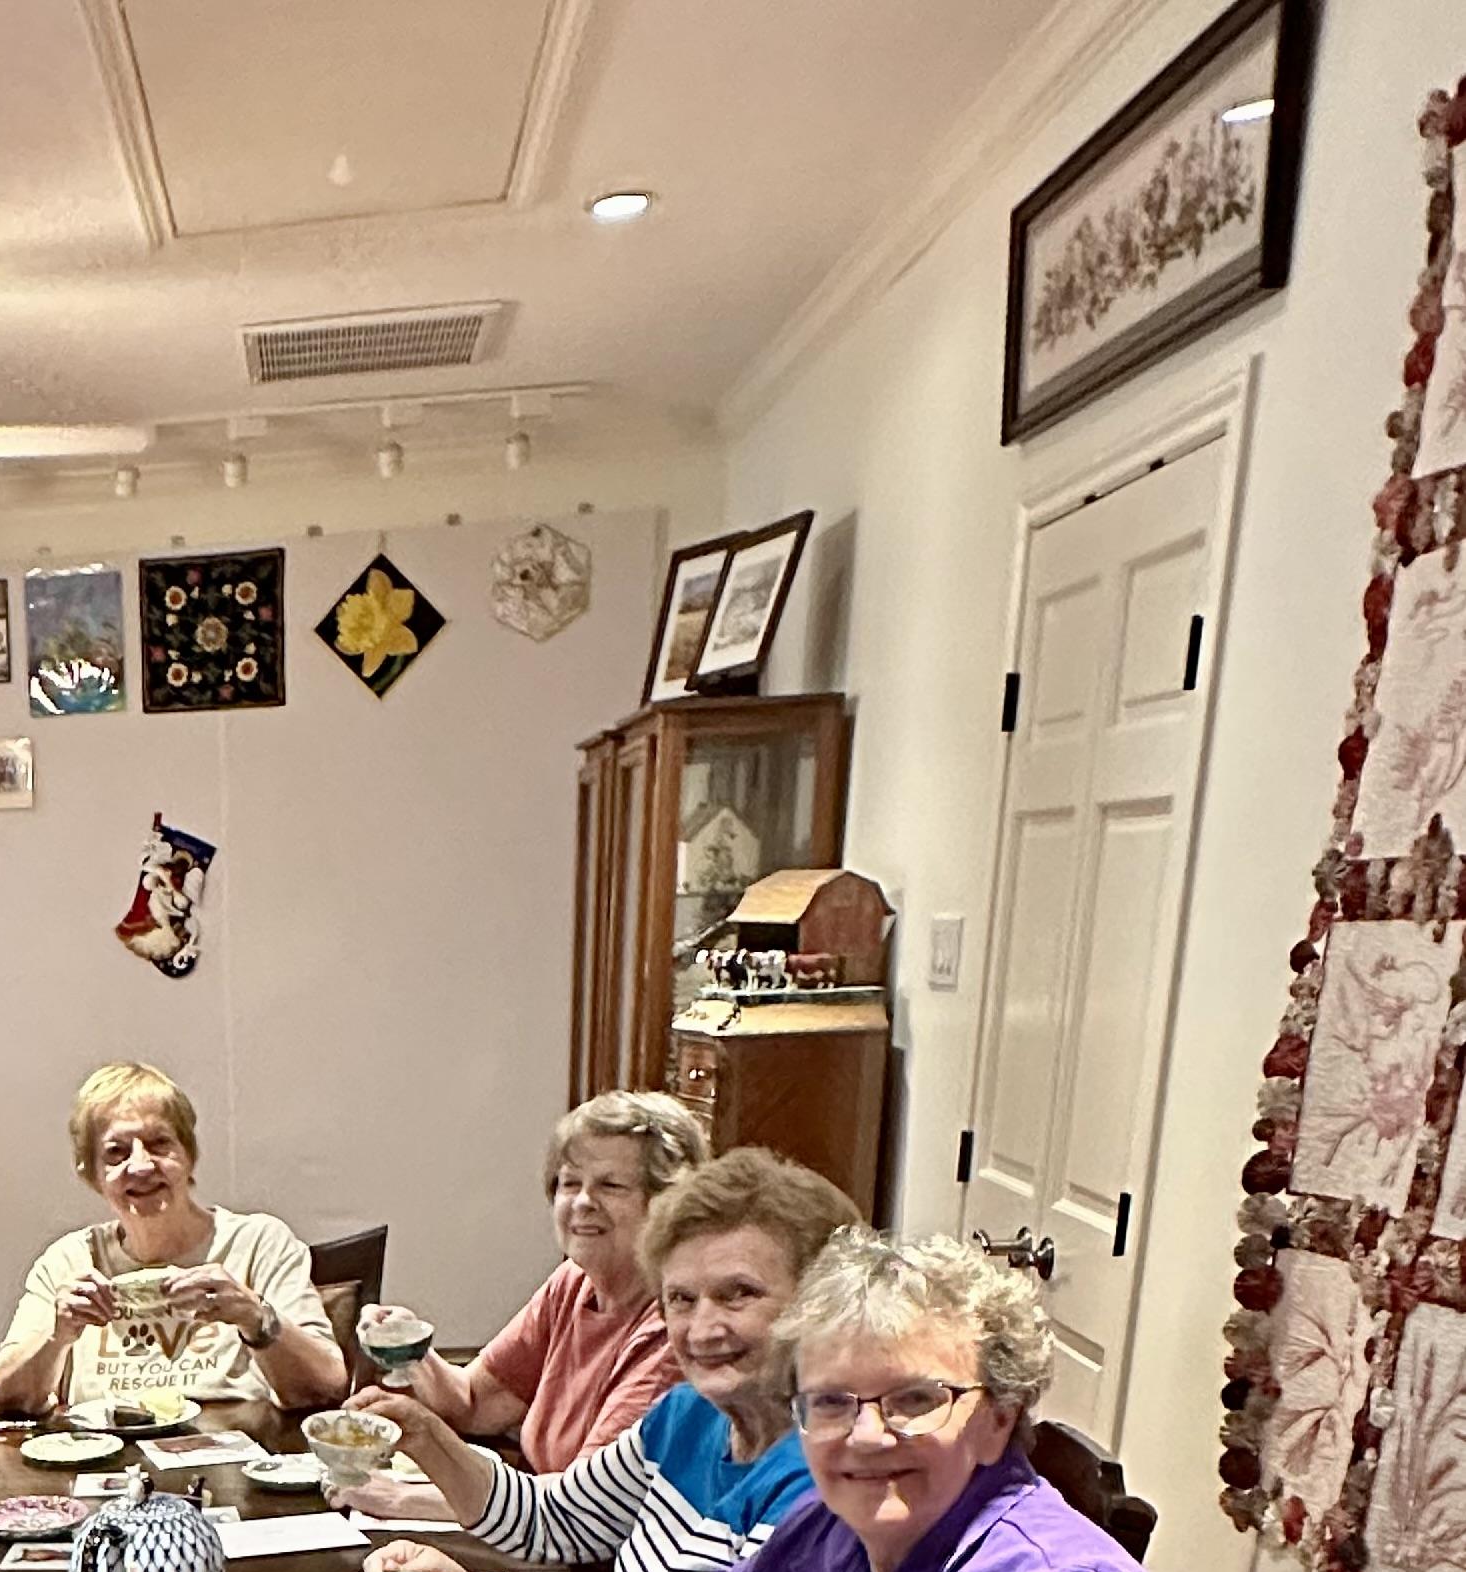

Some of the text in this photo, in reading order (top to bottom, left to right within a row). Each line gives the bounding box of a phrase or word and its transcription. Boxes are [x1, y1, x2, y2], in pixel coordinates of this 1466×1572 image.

[96, 1357, 218, 1375] BUT YOU CAN
[108, 1373, 198, 1391] RESCUE IT
